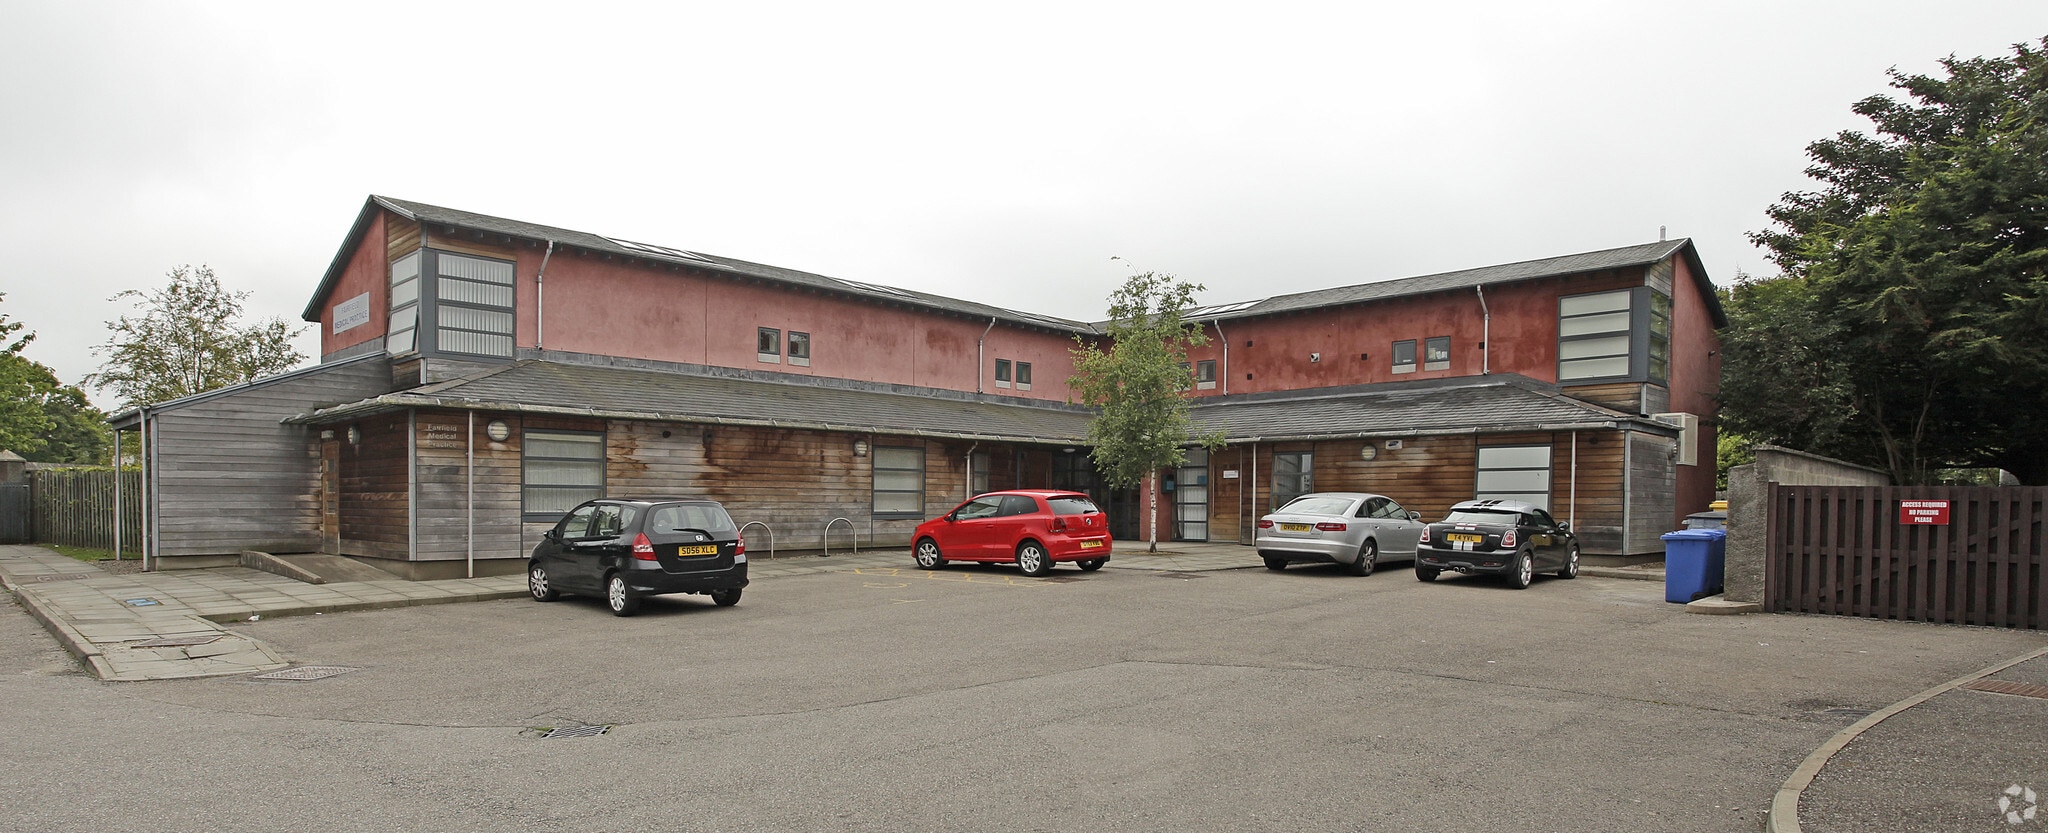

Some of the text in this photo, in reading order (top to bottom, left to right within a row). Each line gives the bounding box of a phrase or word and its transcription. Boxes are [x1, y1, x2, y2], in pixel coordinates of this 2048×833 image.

[427, 423, 457, 432] Fairfield
[428, 432, 457, 440] Medical
[428, 440, 457, 448] Practice
[681, 545, 715, 555] SD56 XLC
